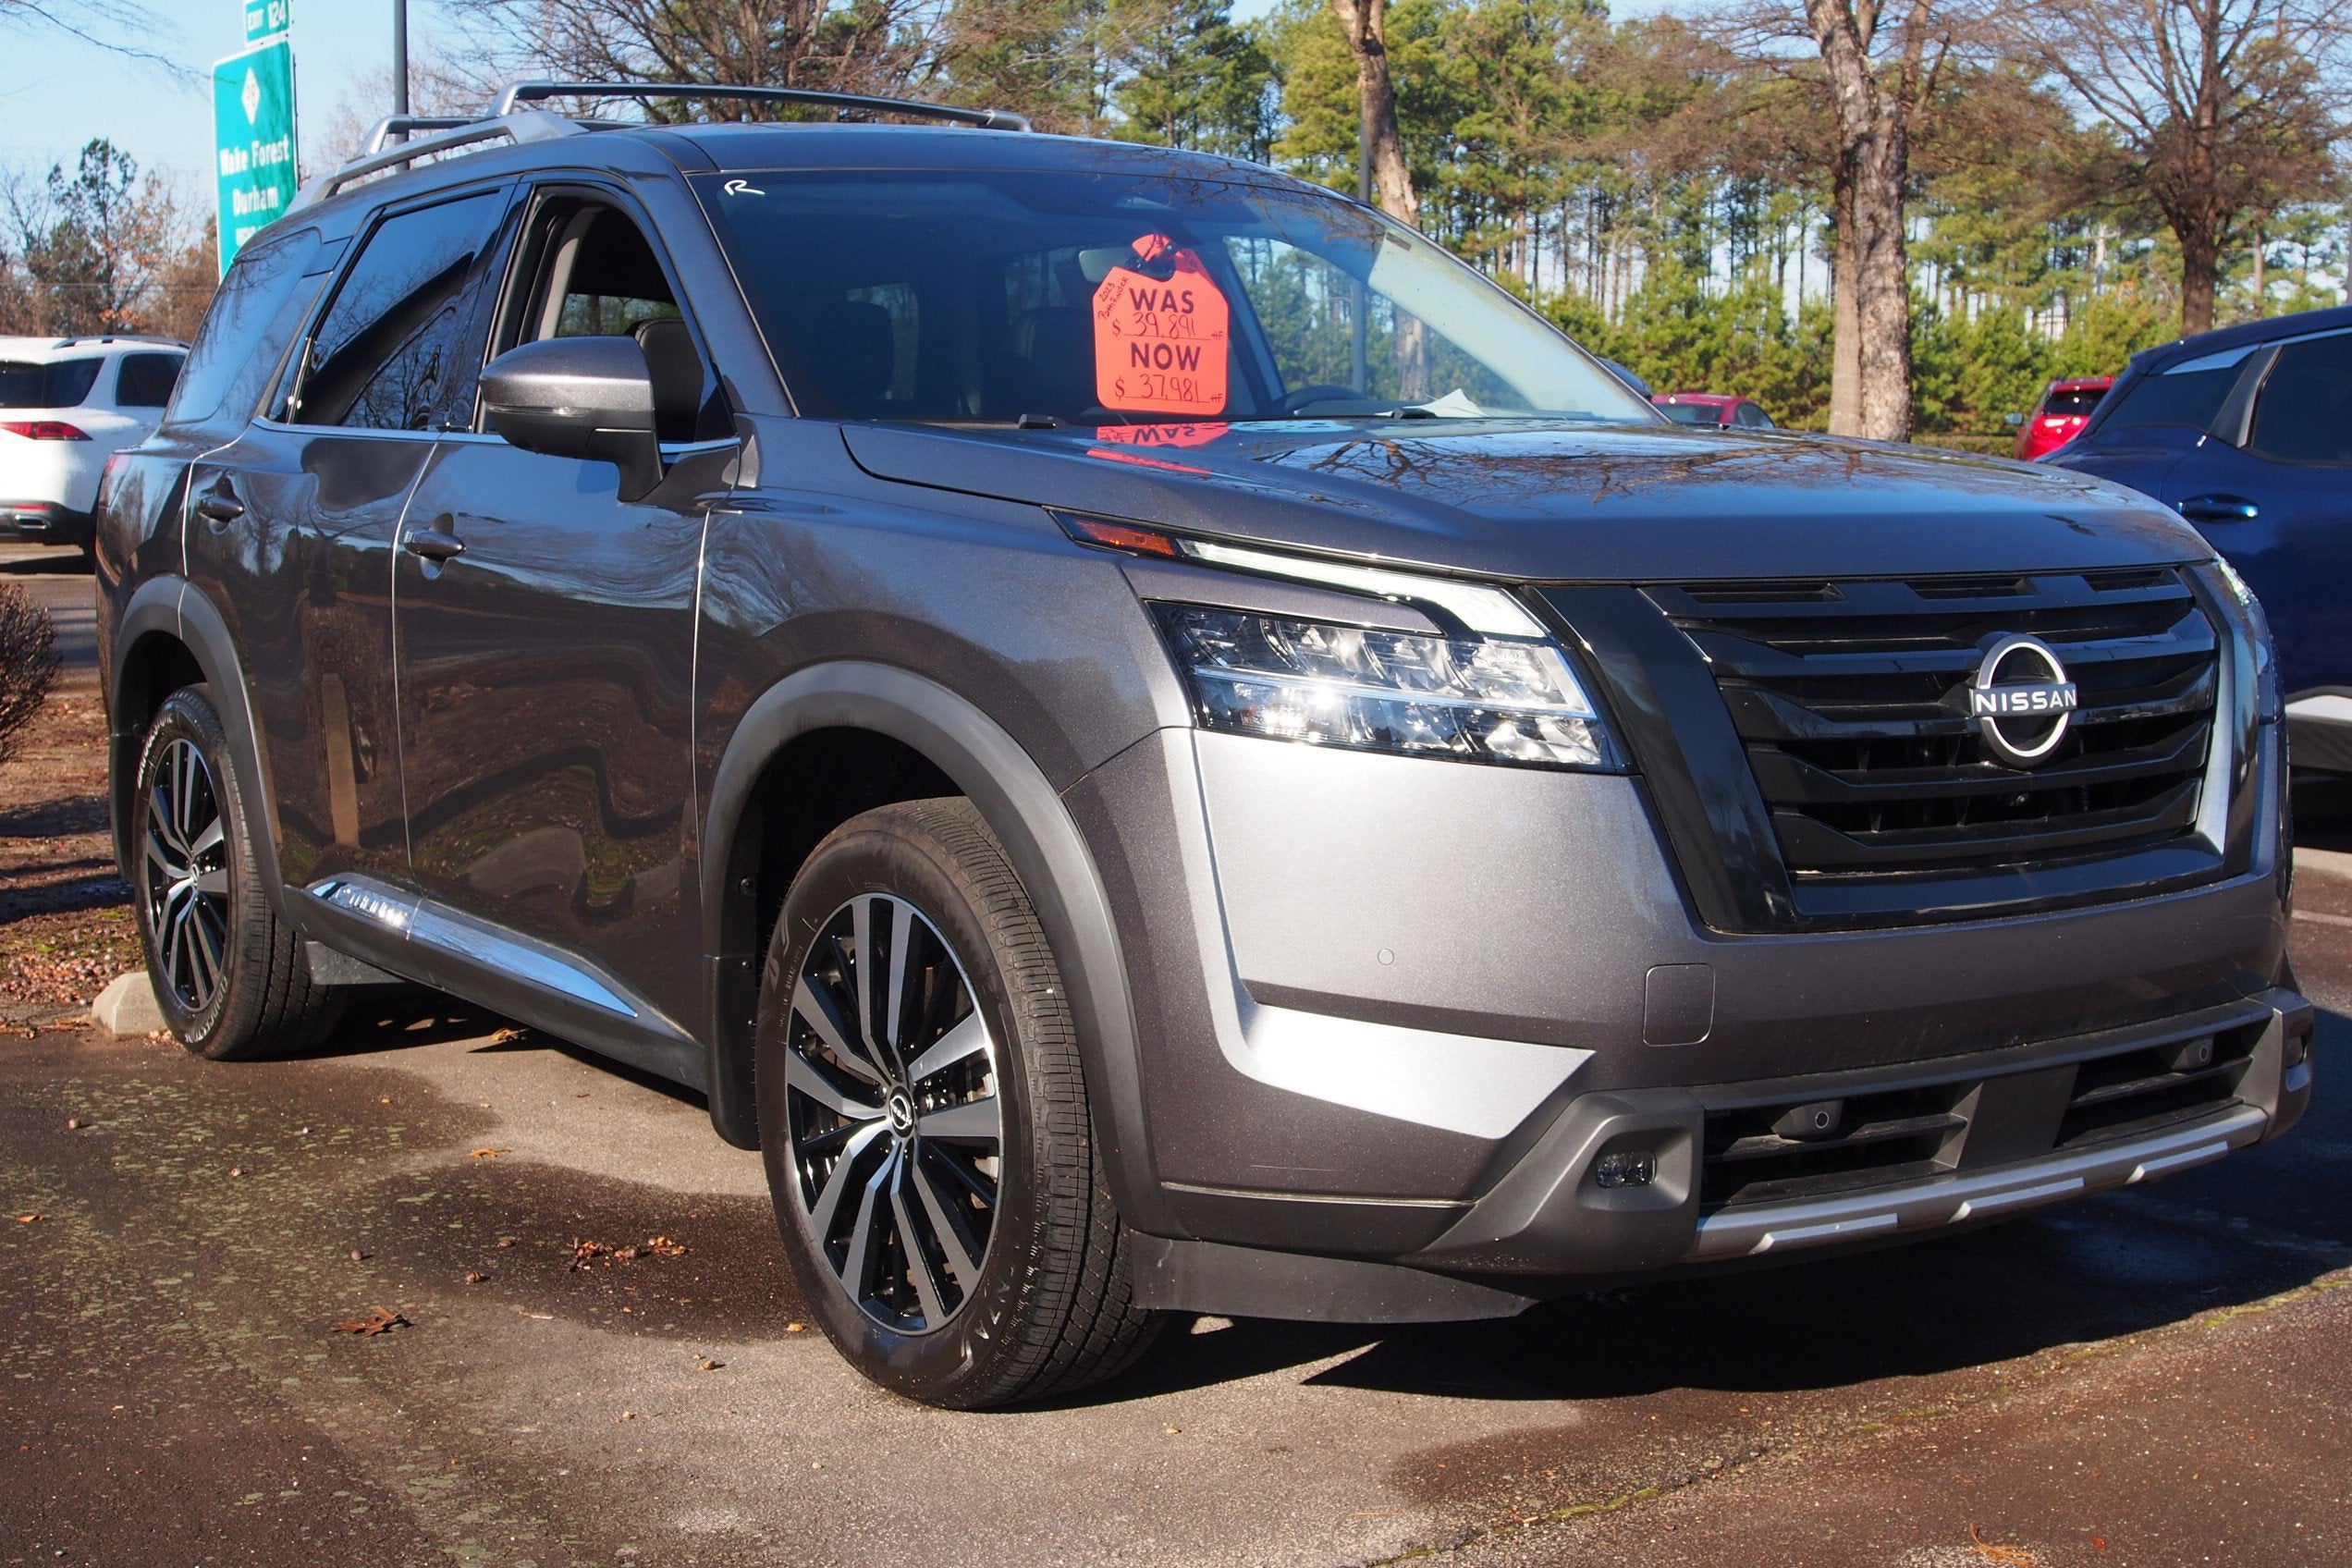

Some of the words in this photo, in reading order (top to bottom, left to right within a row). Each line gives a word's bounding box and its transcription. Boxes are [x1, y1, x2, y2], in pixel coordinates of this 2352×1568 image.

[268, 1, 288, 29] 124
[219, 146, 249, 176] Wake
[251, 133, 289, 168] Forest
[233, 185, 279, 216] Durham
[1129, 288, 1195, 314] WAS
[1131, 341, 1201, 372] NOW
[1975, 689, 2077, 713] NISSAN
